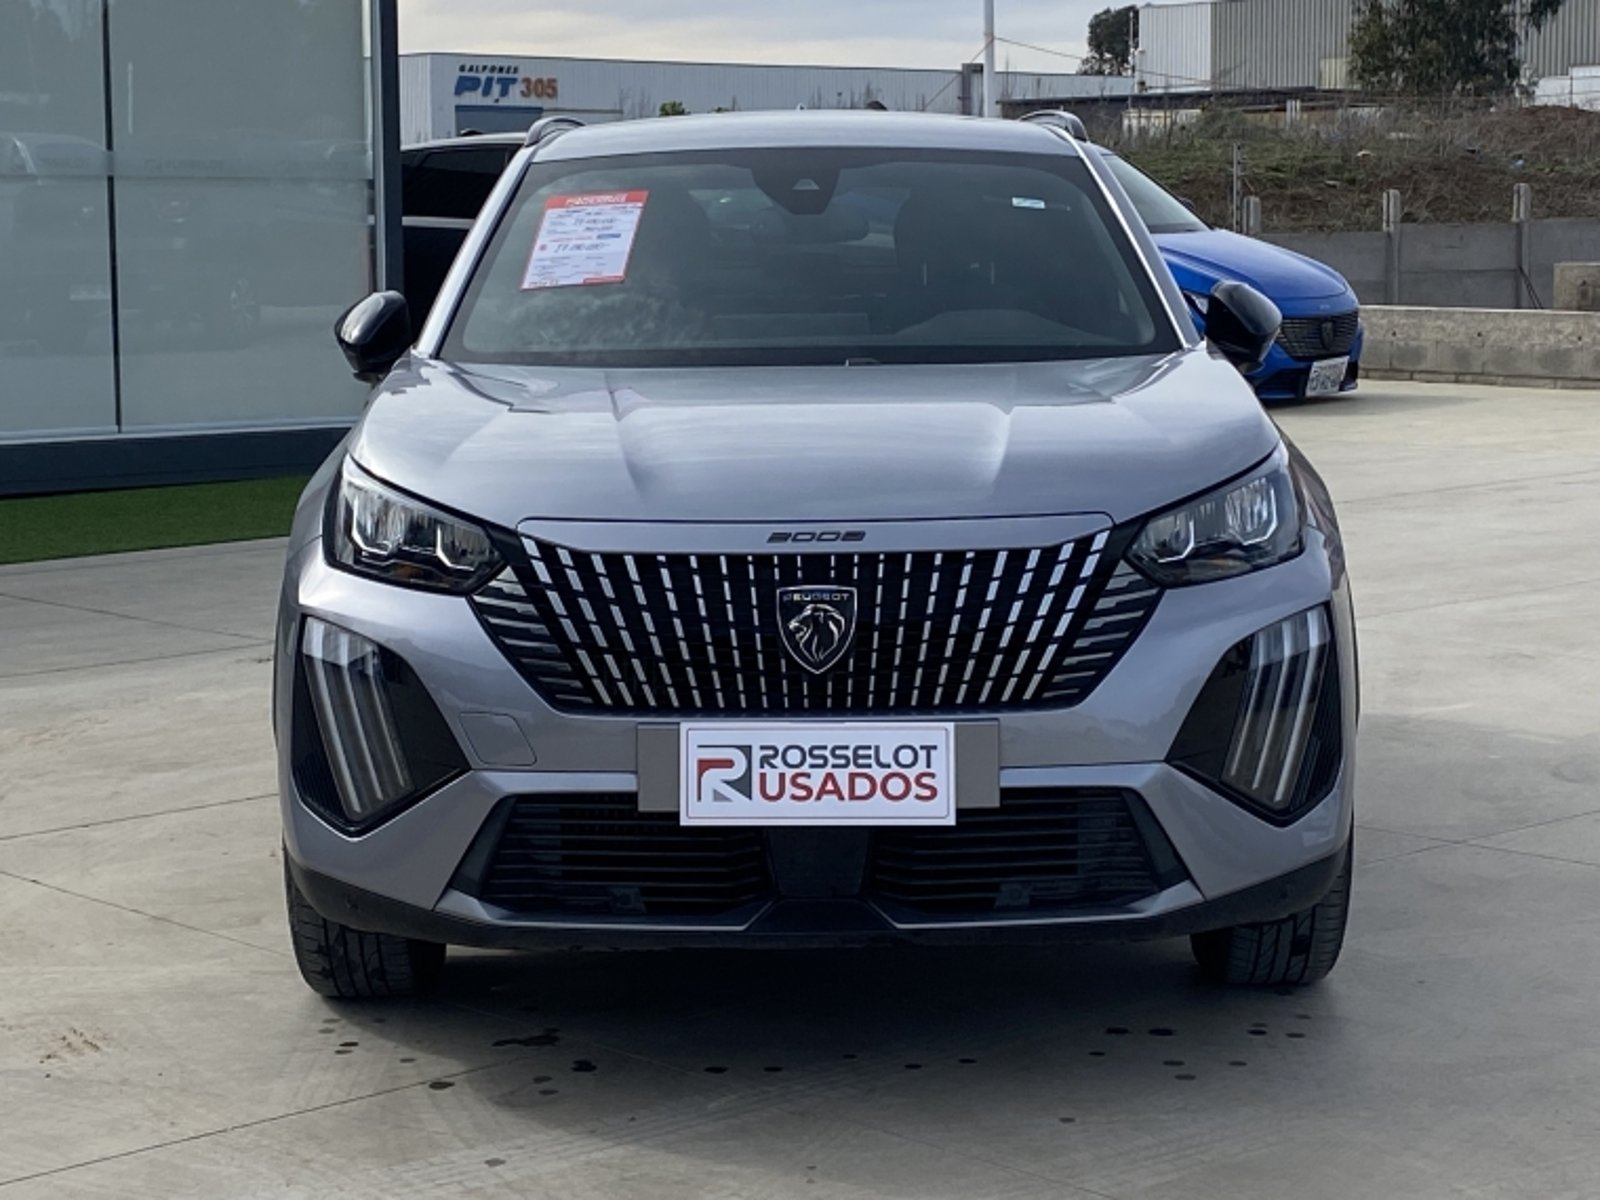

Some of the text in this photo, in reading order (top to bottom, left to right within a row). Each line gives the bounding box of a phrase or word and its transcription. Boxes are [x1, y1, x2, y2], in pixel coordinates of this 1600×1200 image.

[458, 64, 519, 75] GALPONES
[454, 75, 558, 98] PIT 305
[766, 530, 866, 544] 2008
[783, 592, 851, 601] PEUGEOT
[759, 744, 938, 769] ROSSELOT
[759, 772, 938, 802] USADOS
